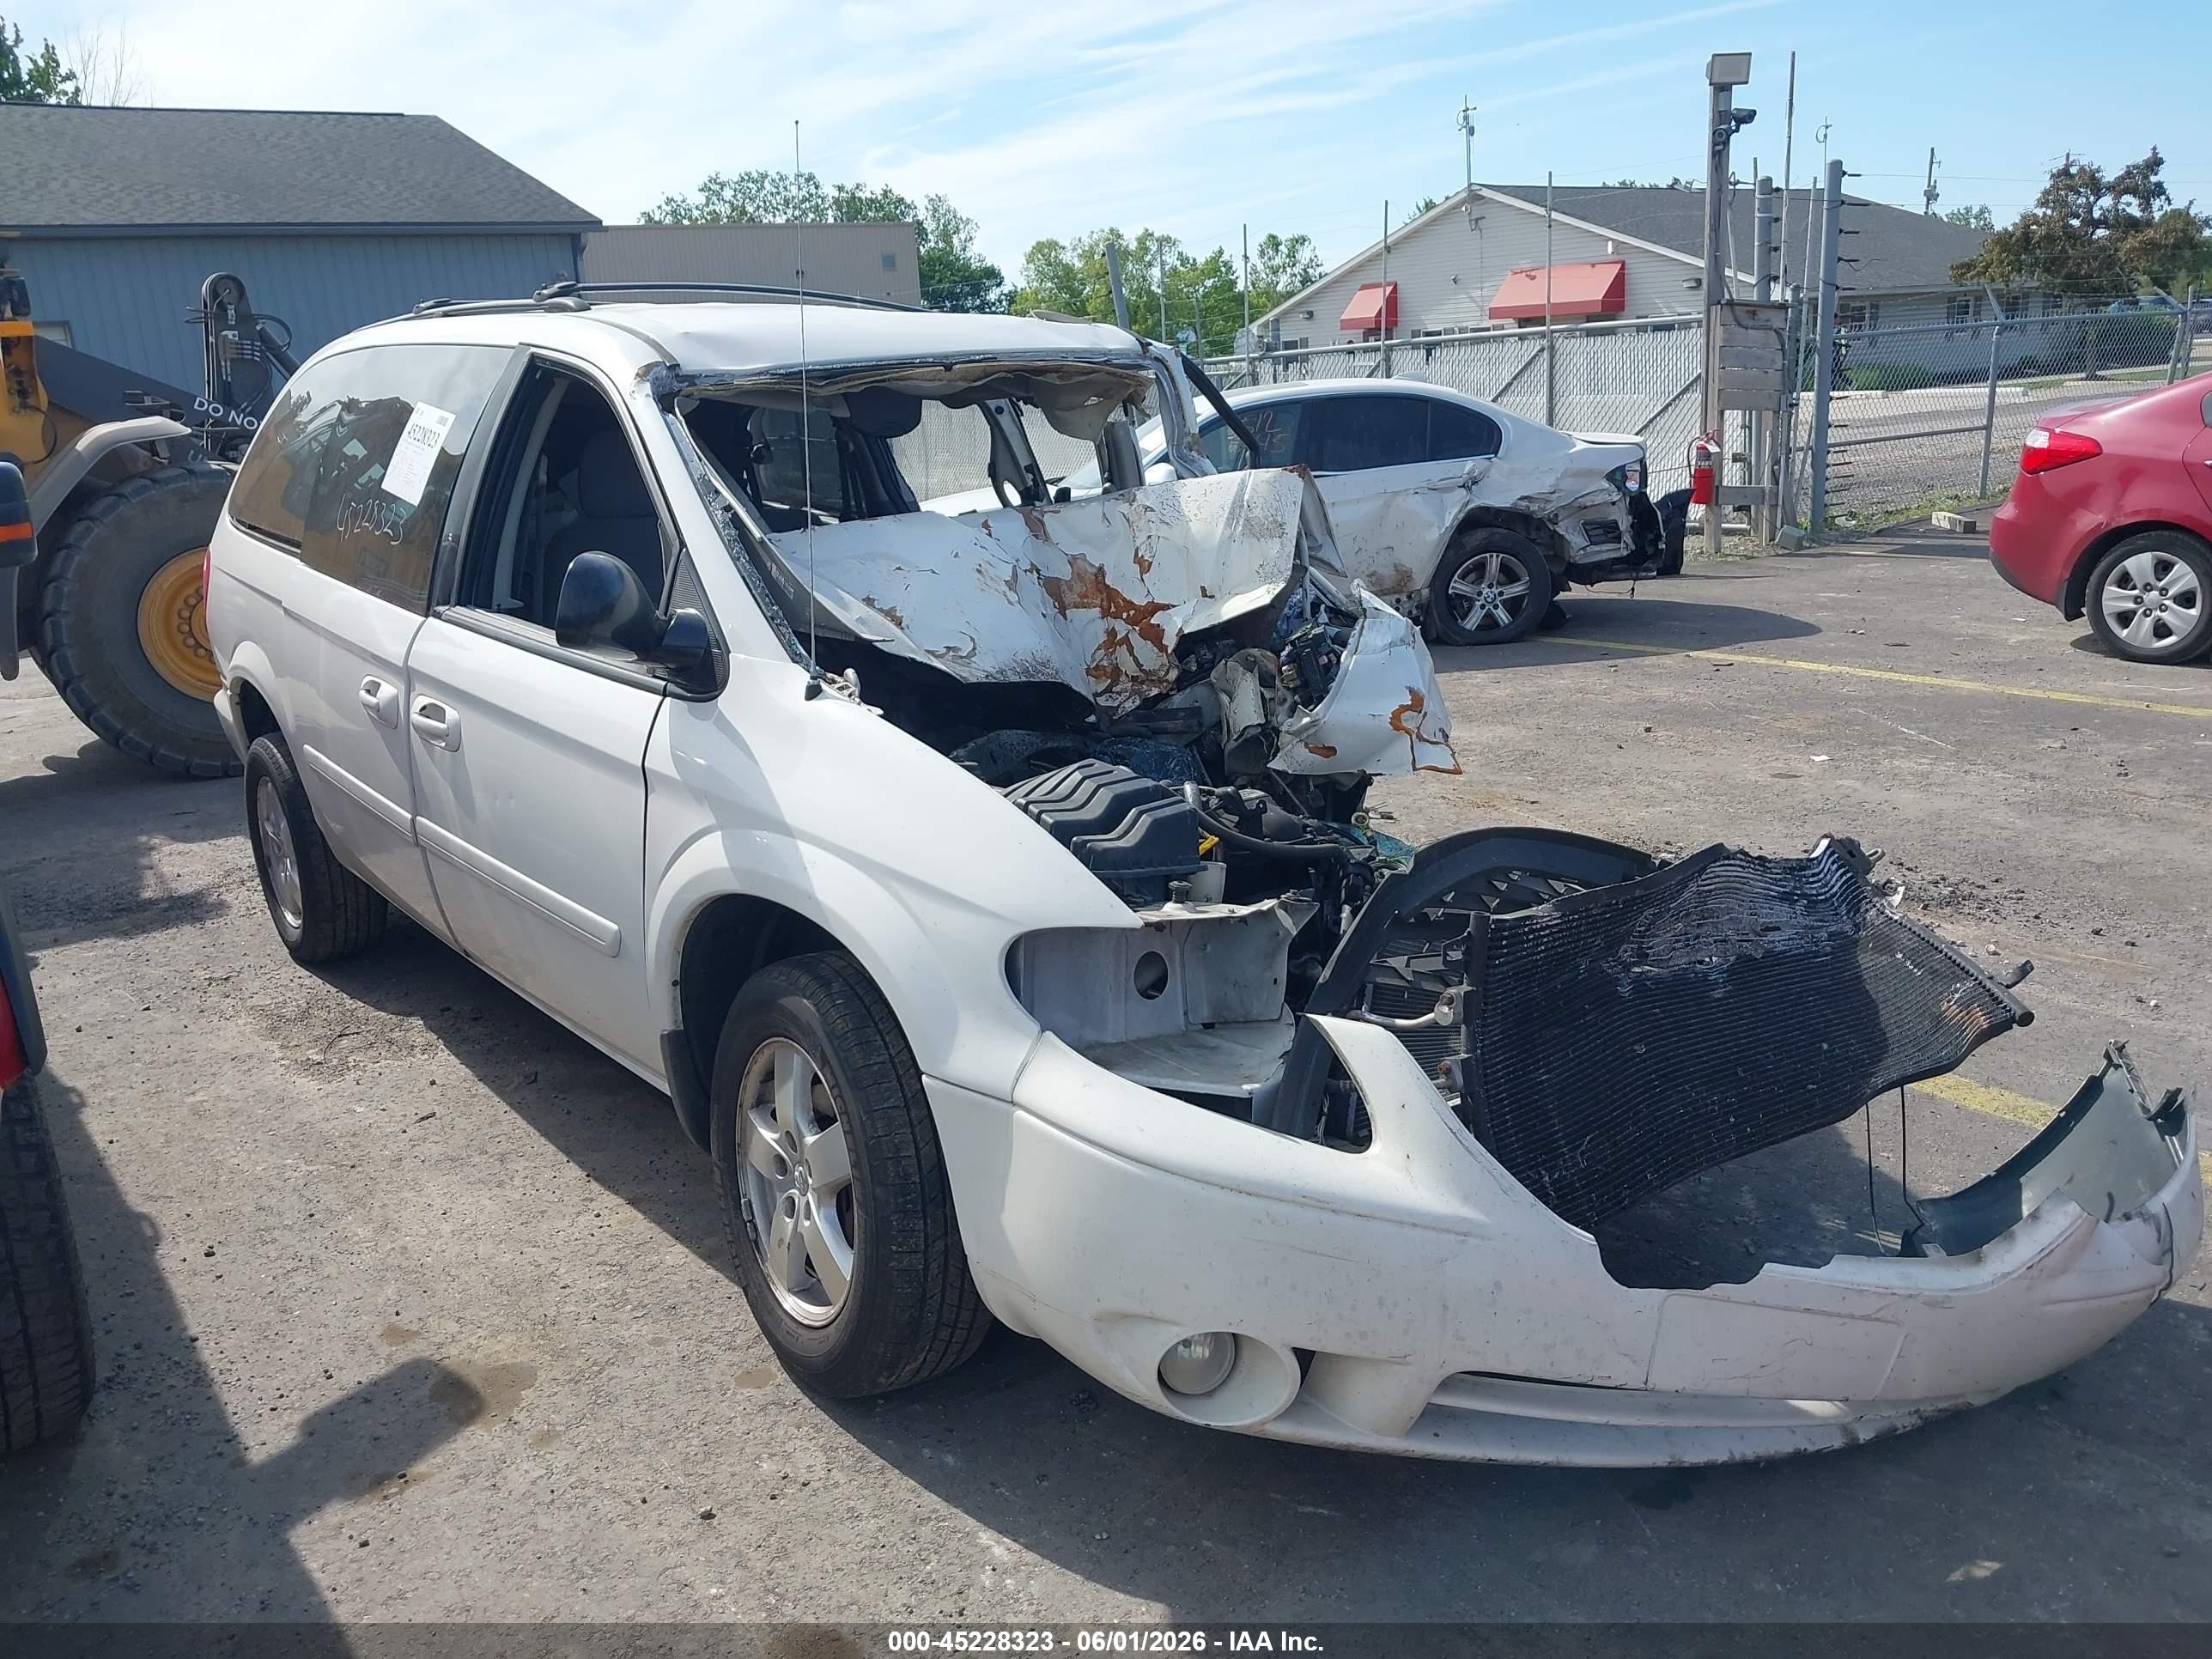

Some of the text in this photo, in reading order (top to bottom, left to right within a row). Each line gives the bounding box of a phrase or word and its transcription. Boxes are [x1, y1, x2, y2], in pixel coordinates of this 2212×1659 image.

[193, 397, 262, 430] DO NO
[337, 493, 406, 545] 45228323
